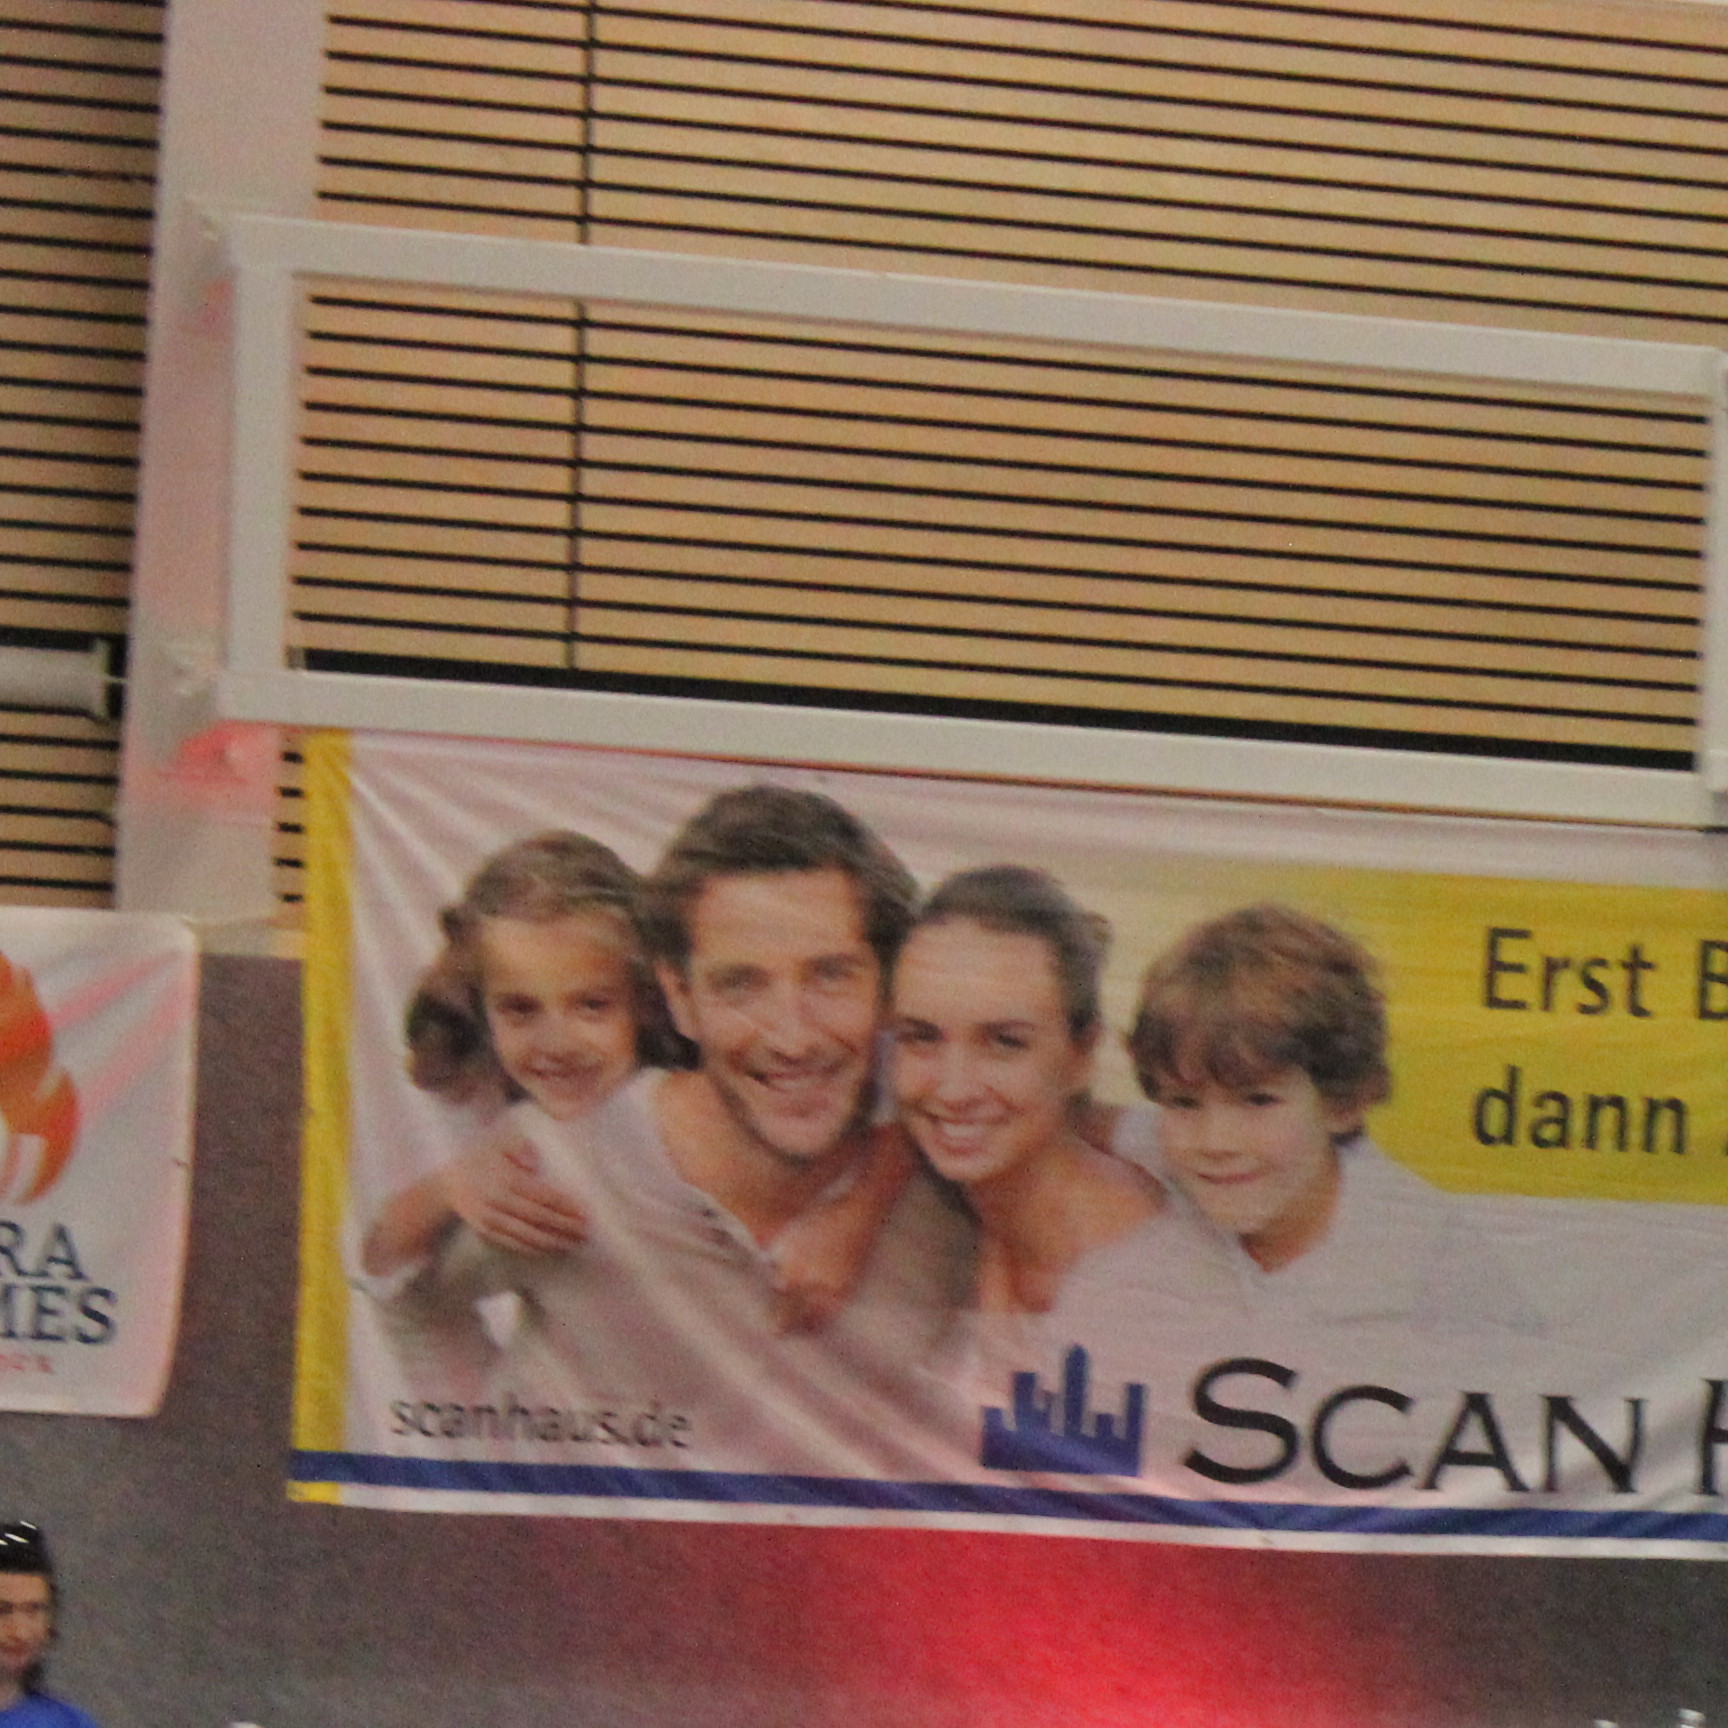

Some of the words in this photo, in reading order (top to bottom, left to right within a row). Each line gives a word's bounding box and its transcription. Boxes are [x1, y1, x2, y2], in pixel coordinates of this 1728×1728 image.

[1484, 926, 1656, 1018] Erst
[1471, 1064, 1689, 1157] dann
[388, 1392, 693, 1449] scanhaus.de
[1183, 1357, 1648, 1494] SCAN
